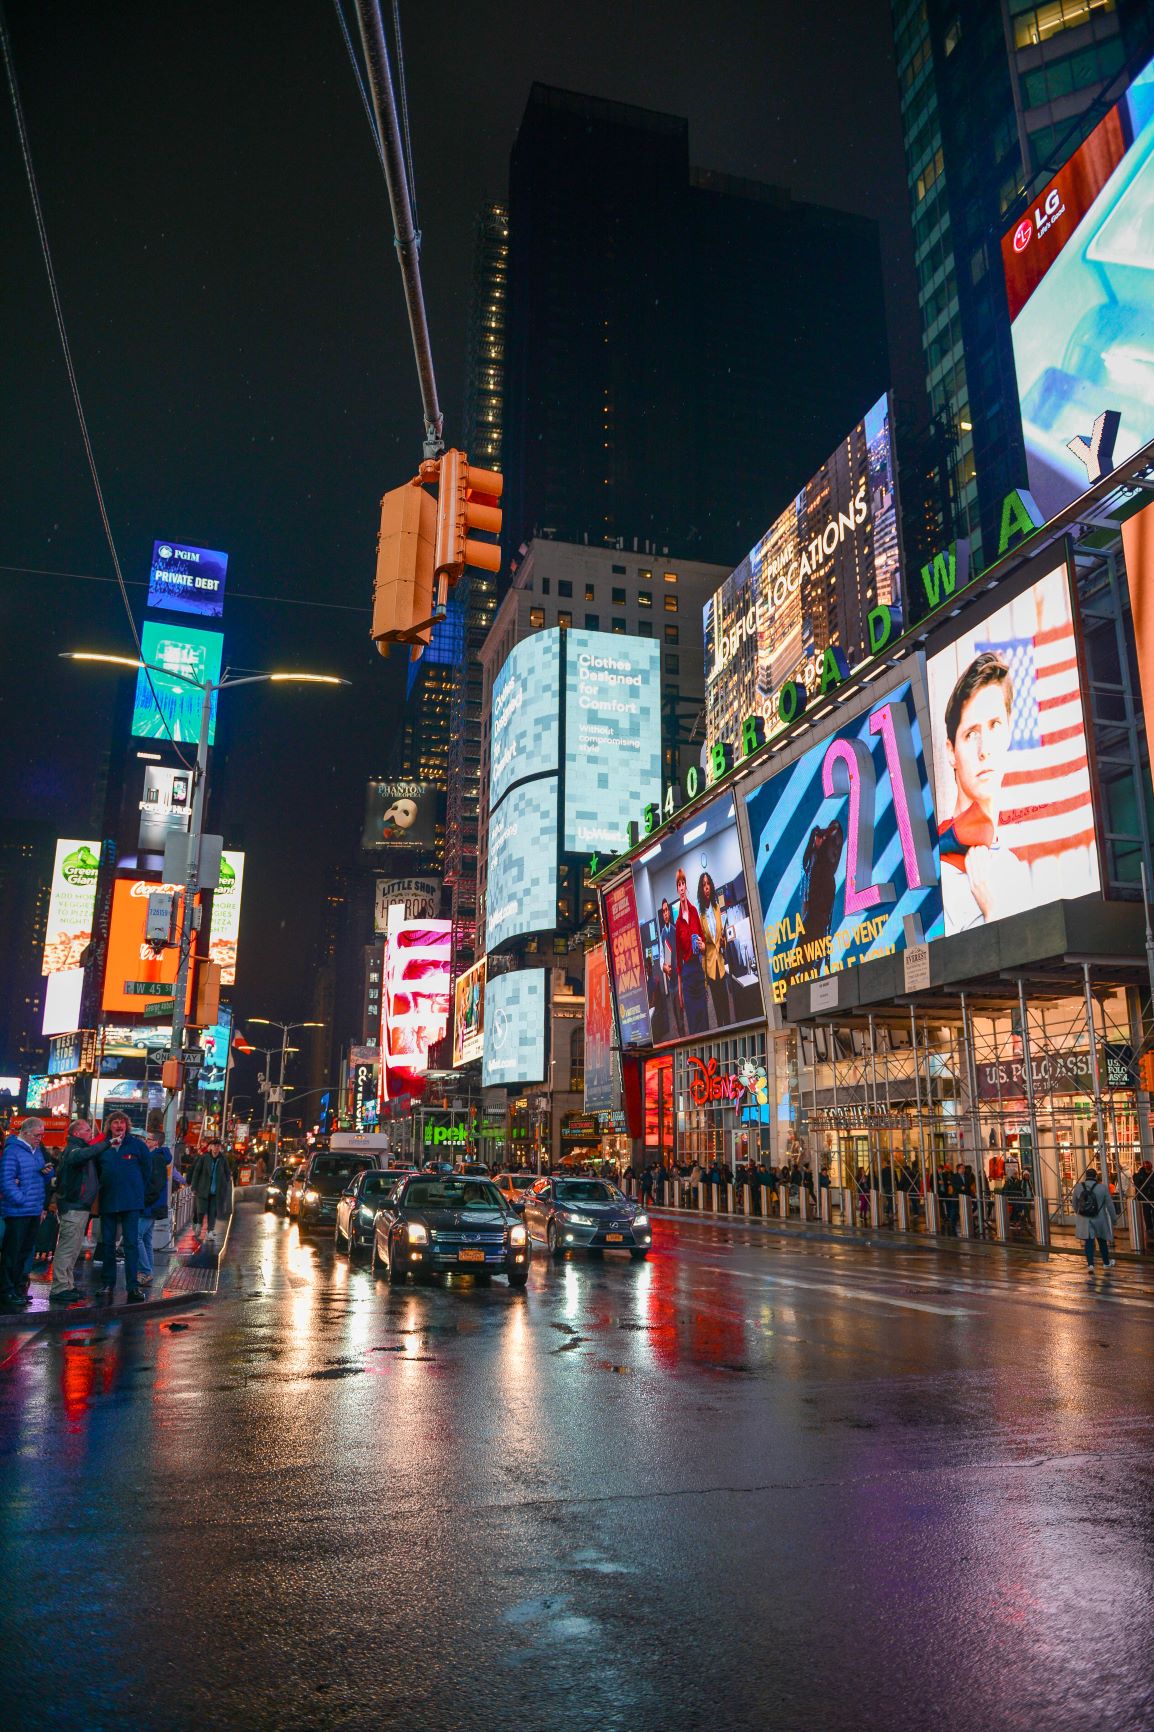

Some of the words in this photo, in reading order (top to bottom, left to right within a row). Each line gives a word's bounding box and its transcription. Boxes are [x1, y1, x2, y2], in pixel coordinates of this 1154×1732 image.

[1034, 188, 1060, 229] LG
[1037, 220, 1052, 240] Life's
[1050, 204, 1066, 224] Good
[174, 549, 200, 562] PGIM
[767, 539, 796, 582] PRIME
[155, 570, 193, 587] PRIVATE
[195, 577, 220, 591] DEBT
[719, 598, 764, 664] OFFICE
[766, 490, 868, 612] LOCATIONS
[579, 654, 632, 671] Clothes
[579, 668, 642, 686] Designed
[579, 682, 599, 695] for
[579, 696, 637, 714] Comfort
[579, 736, 641, 748] compromising
[378, 786, 425, 794] PHANTOM
[65, 866, 98, 875] Green
[382, 880, 413, 897] LITTLE
[414, 881, 436, 896] SHOP
[613, 927, 638, 956] COME
[804, 935, 834, 963] WAYS
[835, 930, 851, 950] TO
[136, 984, 145, 994] W
[149, 984, 161, 994] 45
[772, 979, 787, 1004] EP
[56, 1034, 75, 1049] WEST
[55, 1046, 74, 1060] SIDE
[184, 1053, 199, 1062] AY
[1107, 1059, 1120, 1067] U.S.
